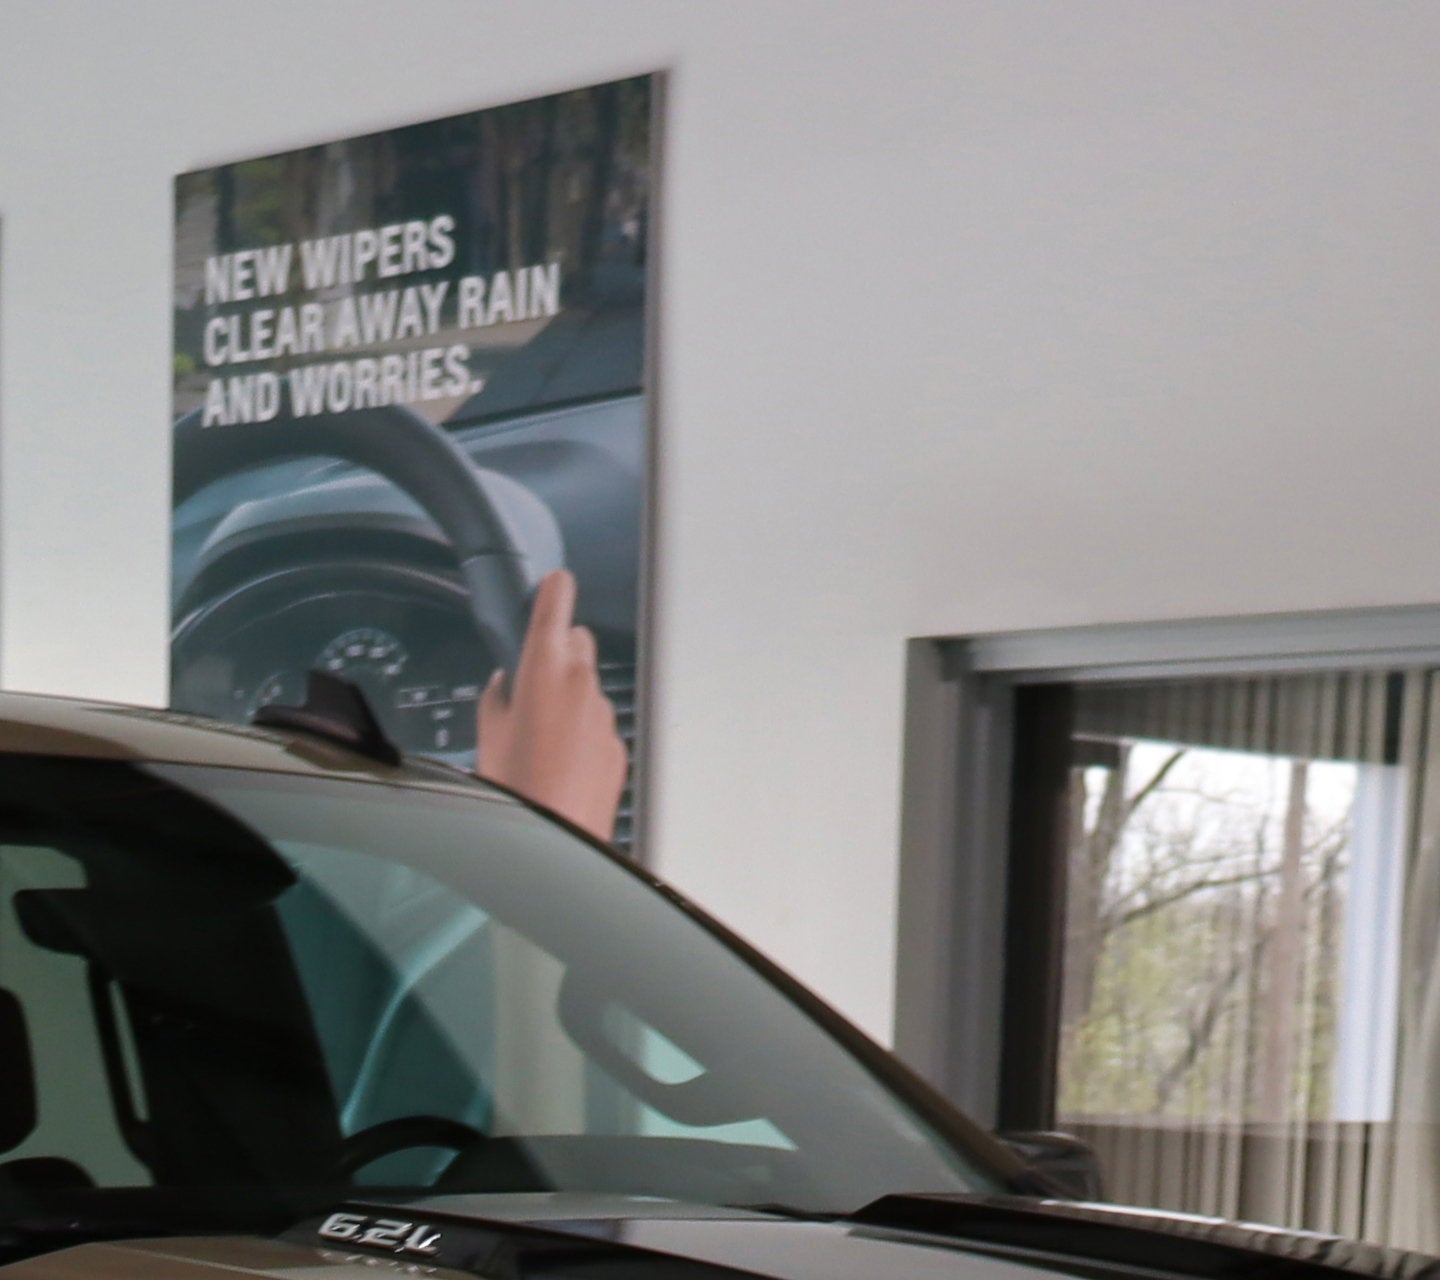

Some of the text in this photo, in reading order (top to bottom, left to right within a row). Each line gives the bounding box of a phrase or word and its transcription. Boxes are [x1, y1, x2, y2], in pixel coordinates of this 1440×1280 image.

[204, 213, 456, 306] NEW WIPERS
[203, 261, 562, 368] CLEAR AWAY RAIN
[200, 344, 486, 429] AND WORRIES.
[318, 1211, 443, 1257] 6.2L
